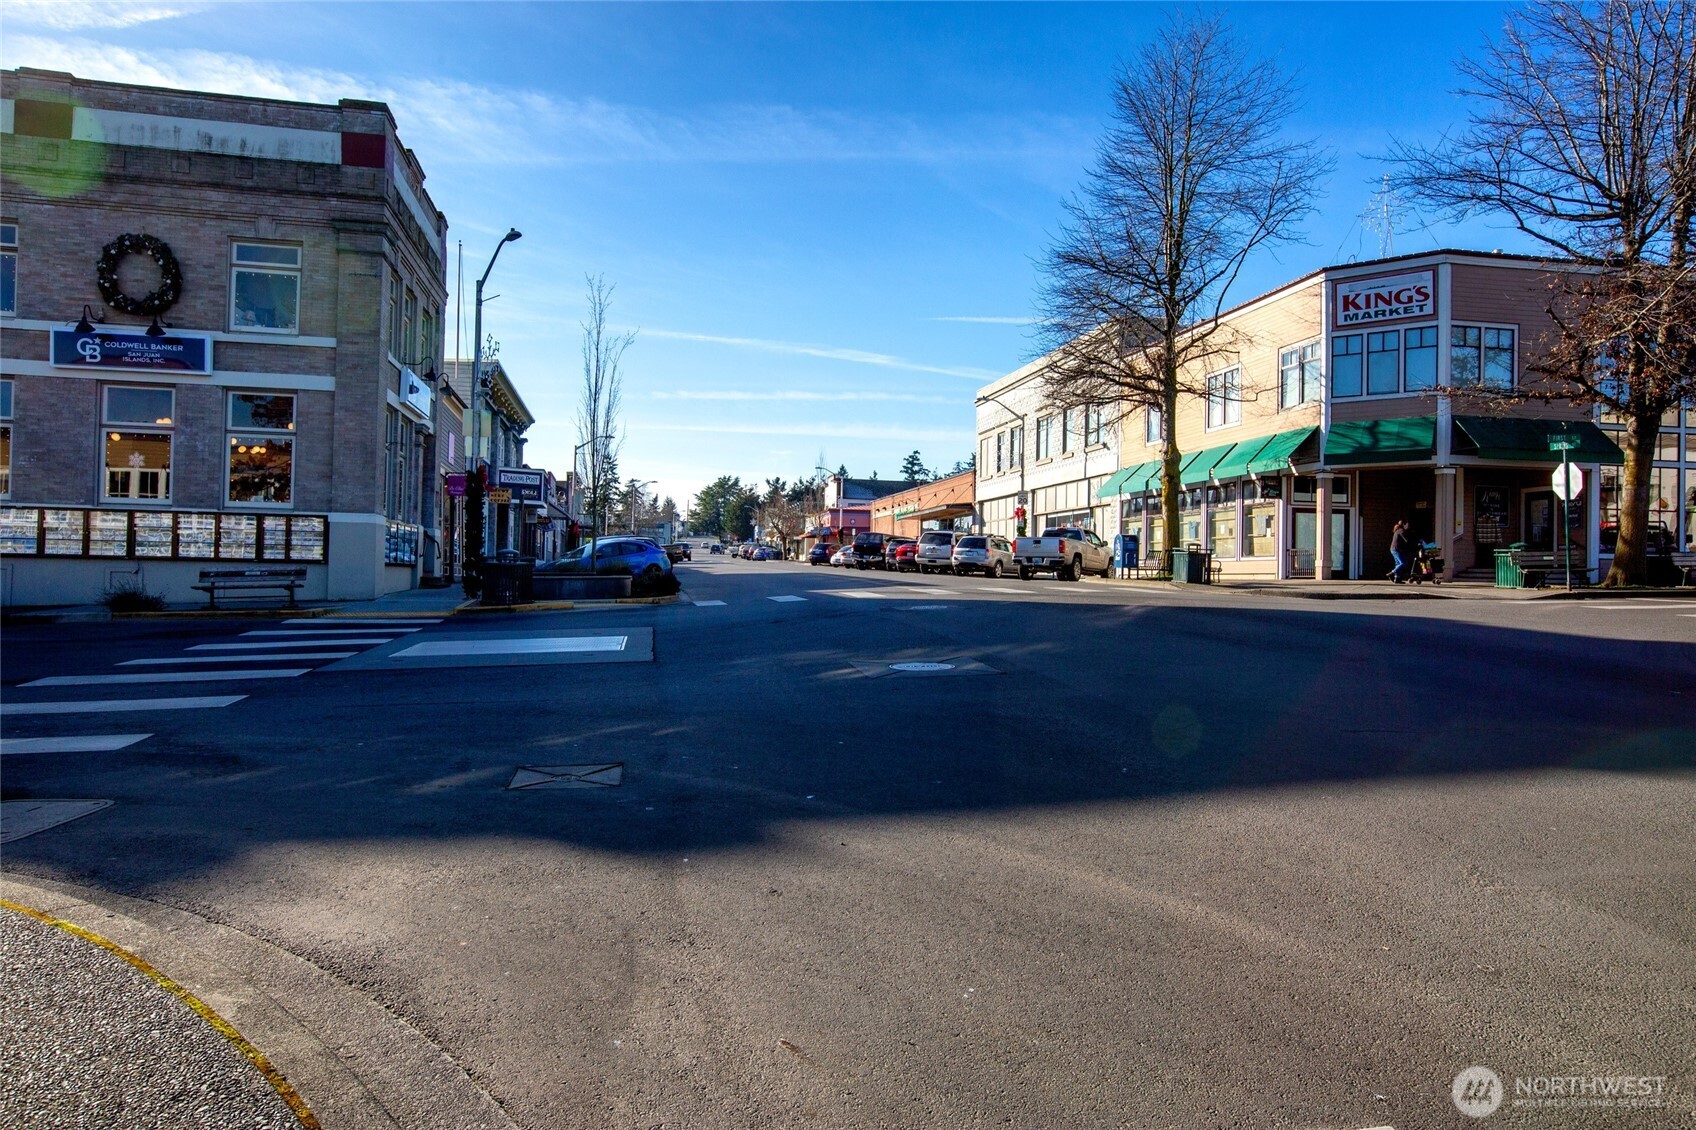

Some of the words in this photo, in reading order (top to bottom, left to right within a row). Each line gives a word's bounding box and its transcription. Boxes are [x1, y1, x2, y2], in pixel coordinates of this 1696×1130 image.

[1342, 285, 1430, 312] KING'S
[1344, 303, 1427, 322] MARKET
[104, 341, 149, 350] COLDWELL
[150, 343, 184, 352] BANKER
